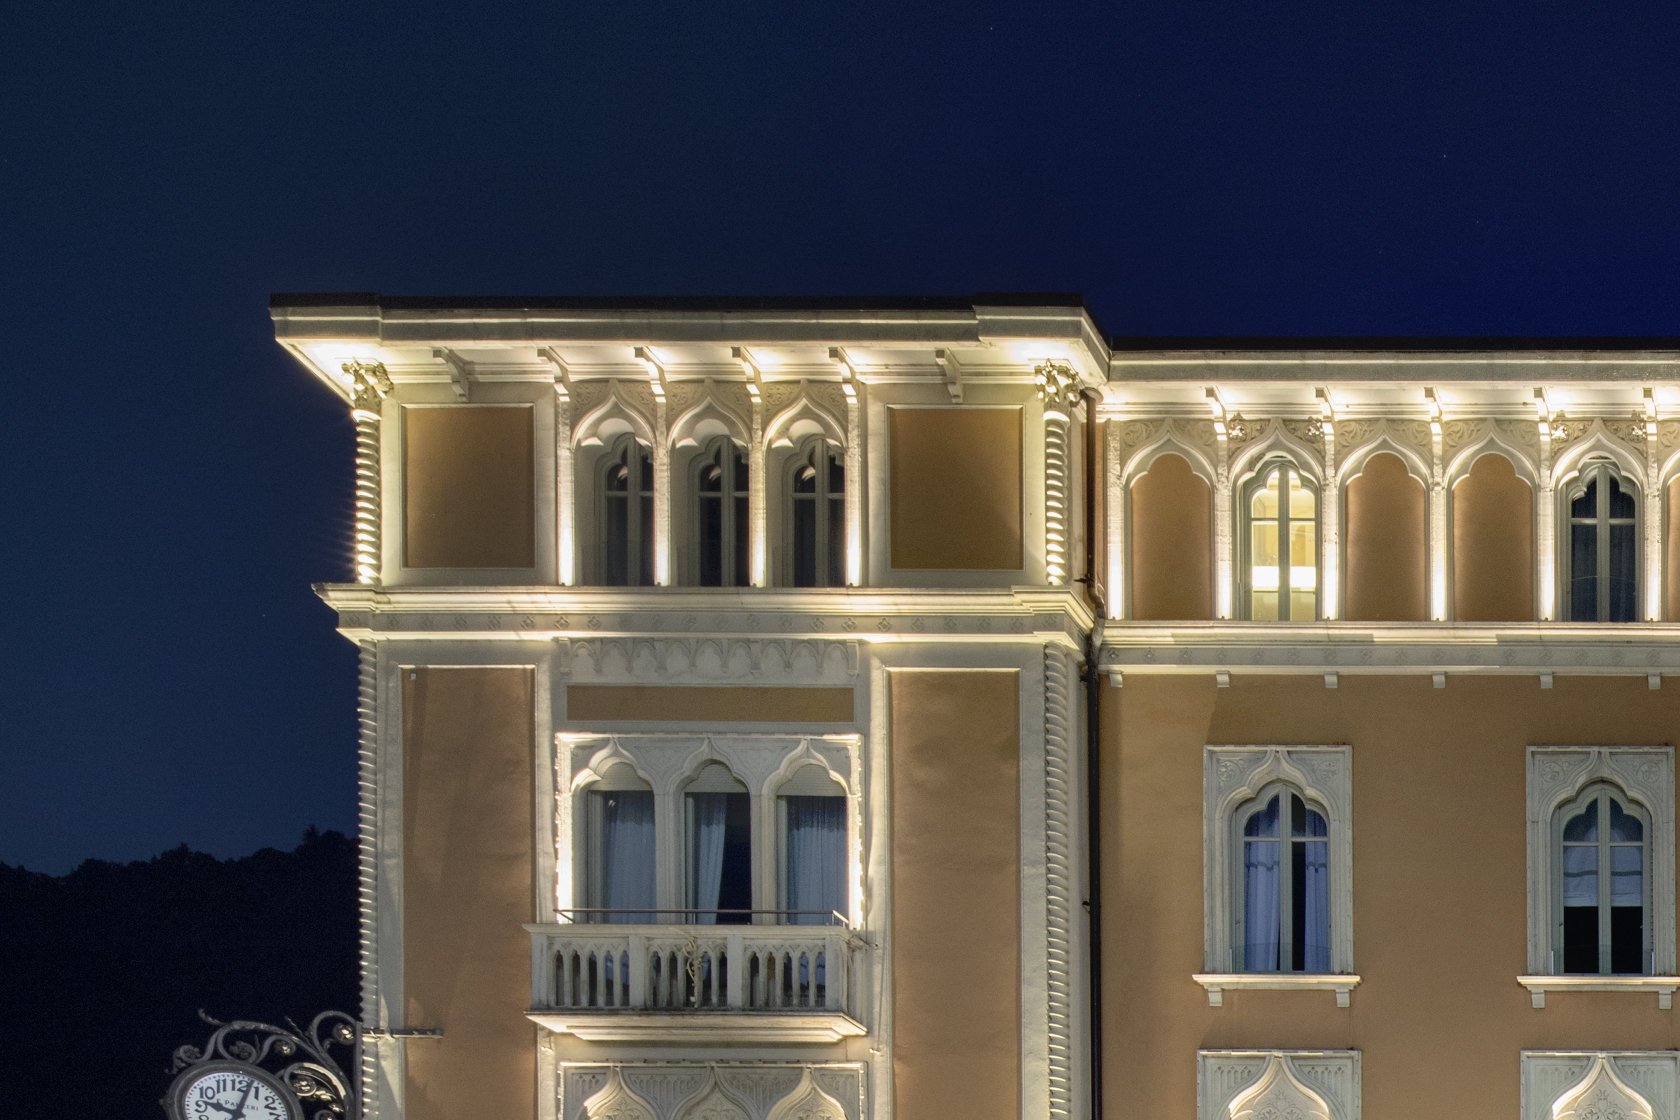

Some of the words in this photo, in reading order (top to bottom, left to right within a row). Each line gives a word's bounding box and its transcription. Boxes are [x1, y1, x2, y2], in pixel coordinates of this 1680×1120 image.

[199, 1086, 216, 1100] 10
[214, 1078, 227, 1094] 11
[230, 1078, 248, 1093] 12
[253, 1086, 260, 1101] 1
[194, 1099, 208, 1113] 9
[264, 1095, 277, 1111] 2
